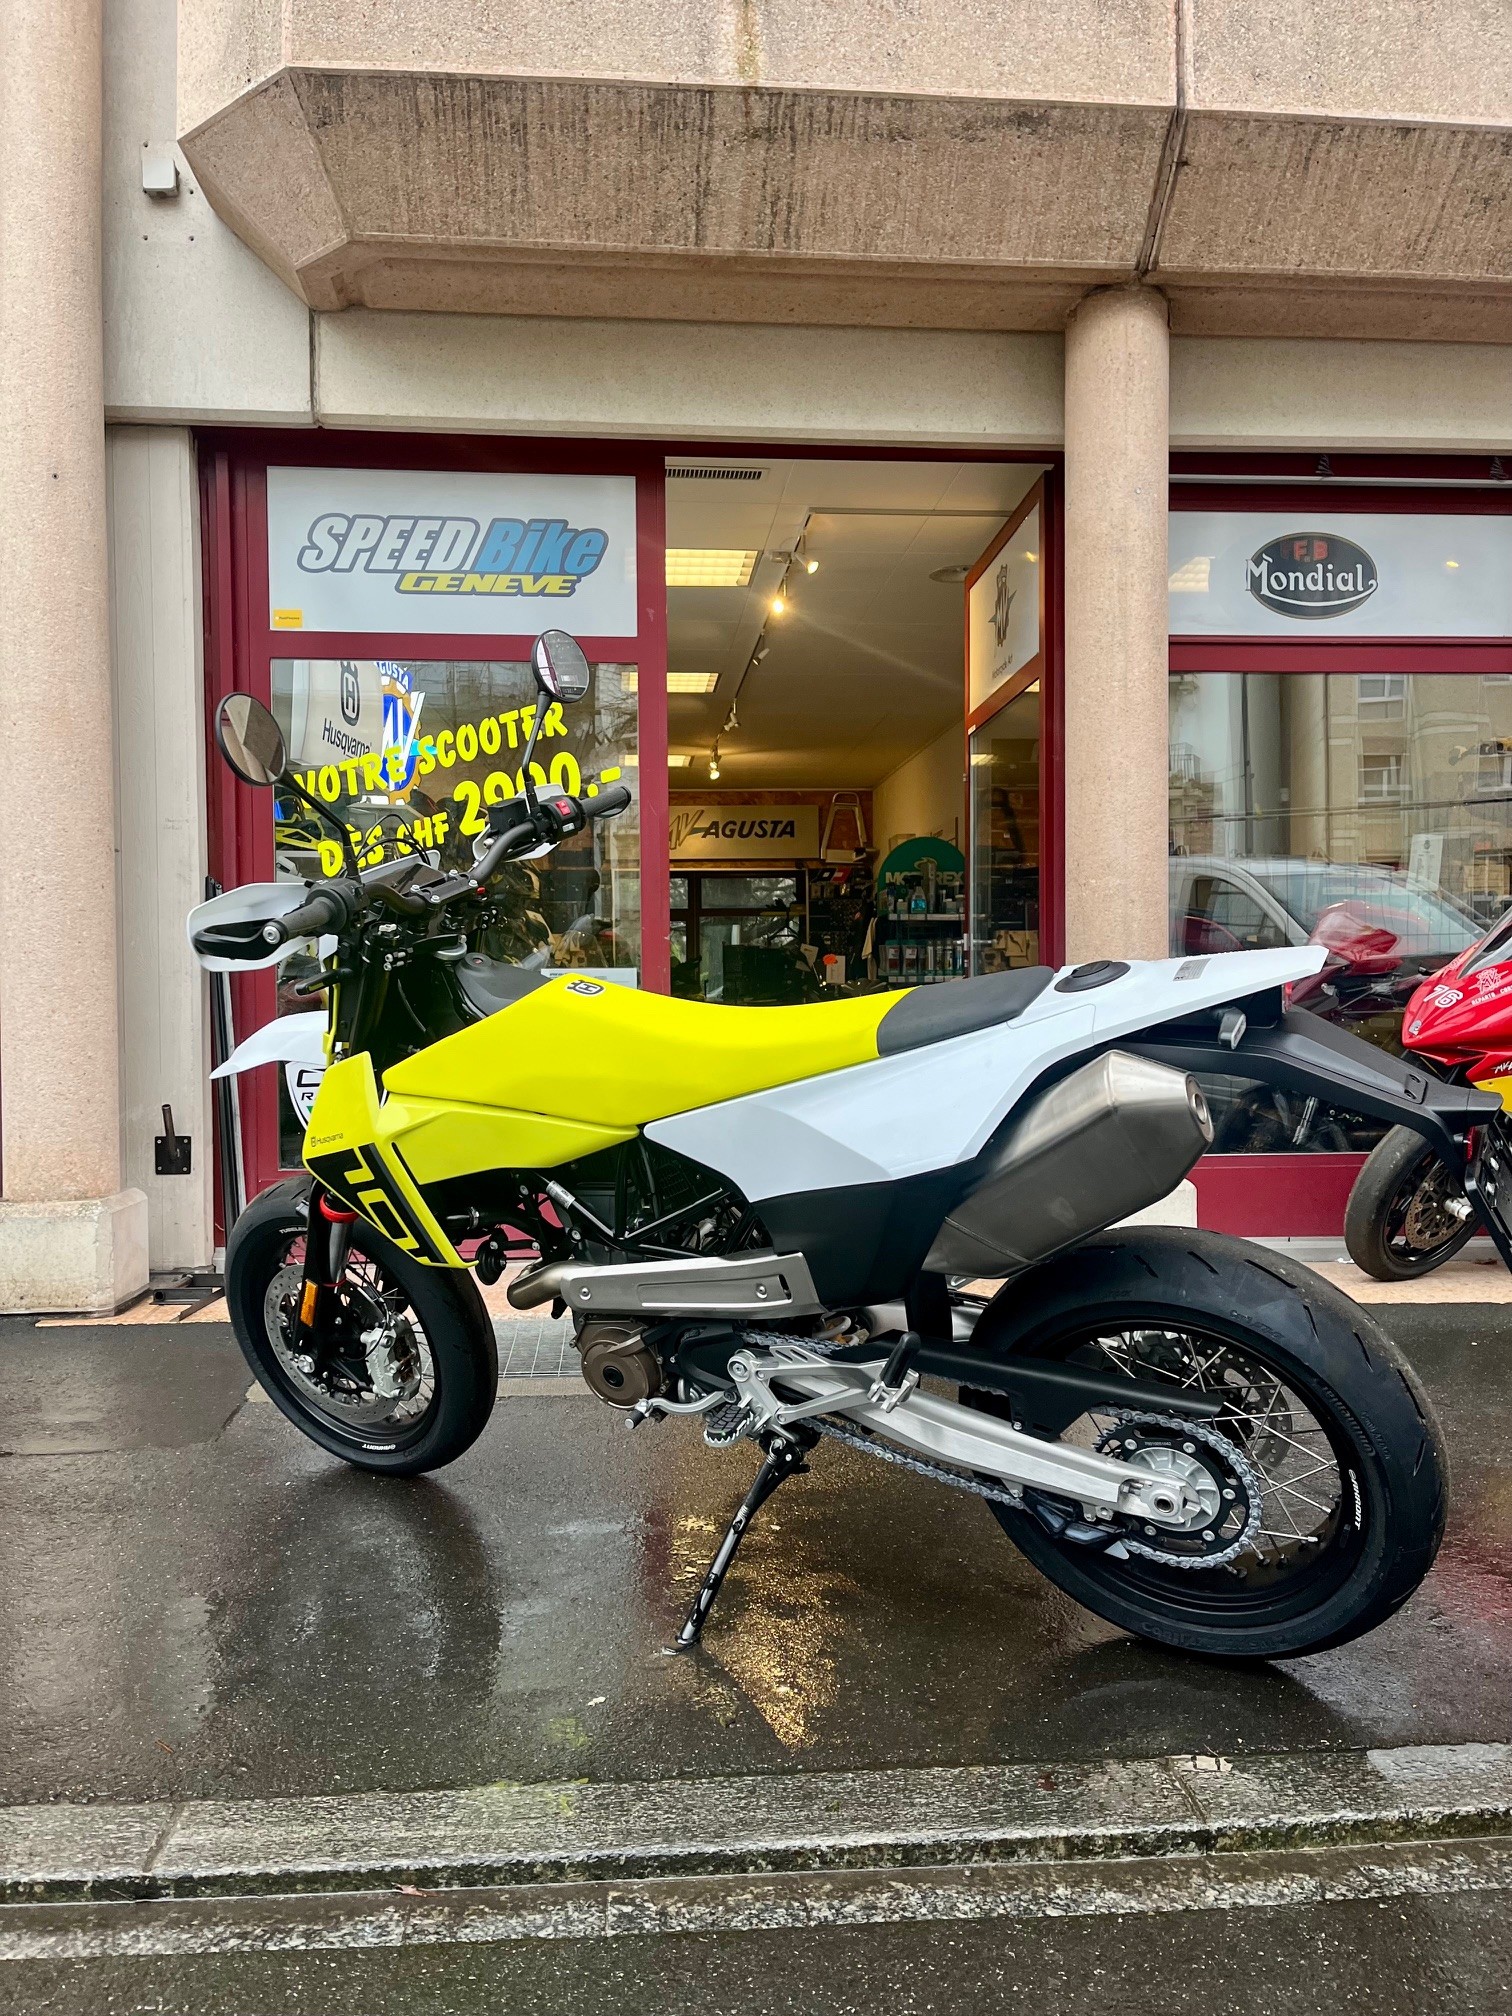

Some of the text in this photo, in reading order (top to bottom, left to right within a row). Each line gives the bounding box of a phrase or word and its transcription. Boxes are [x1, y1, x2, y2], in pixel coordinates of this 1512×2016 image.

[298, 514, 607, 576] SPEED Bike
[398, 572, 581, 596] GENEVE
[1245, 554, 1378, 606] Mondial
[294, 701, 568, 809] VOTRE SCOOTER
[322, 717, 371, 758] Husqvarna
[396, 811, 449, 855] CHF
[701, 820, 795, 838] AGUSTA
[1423, 984, 1463, 1008] 76
